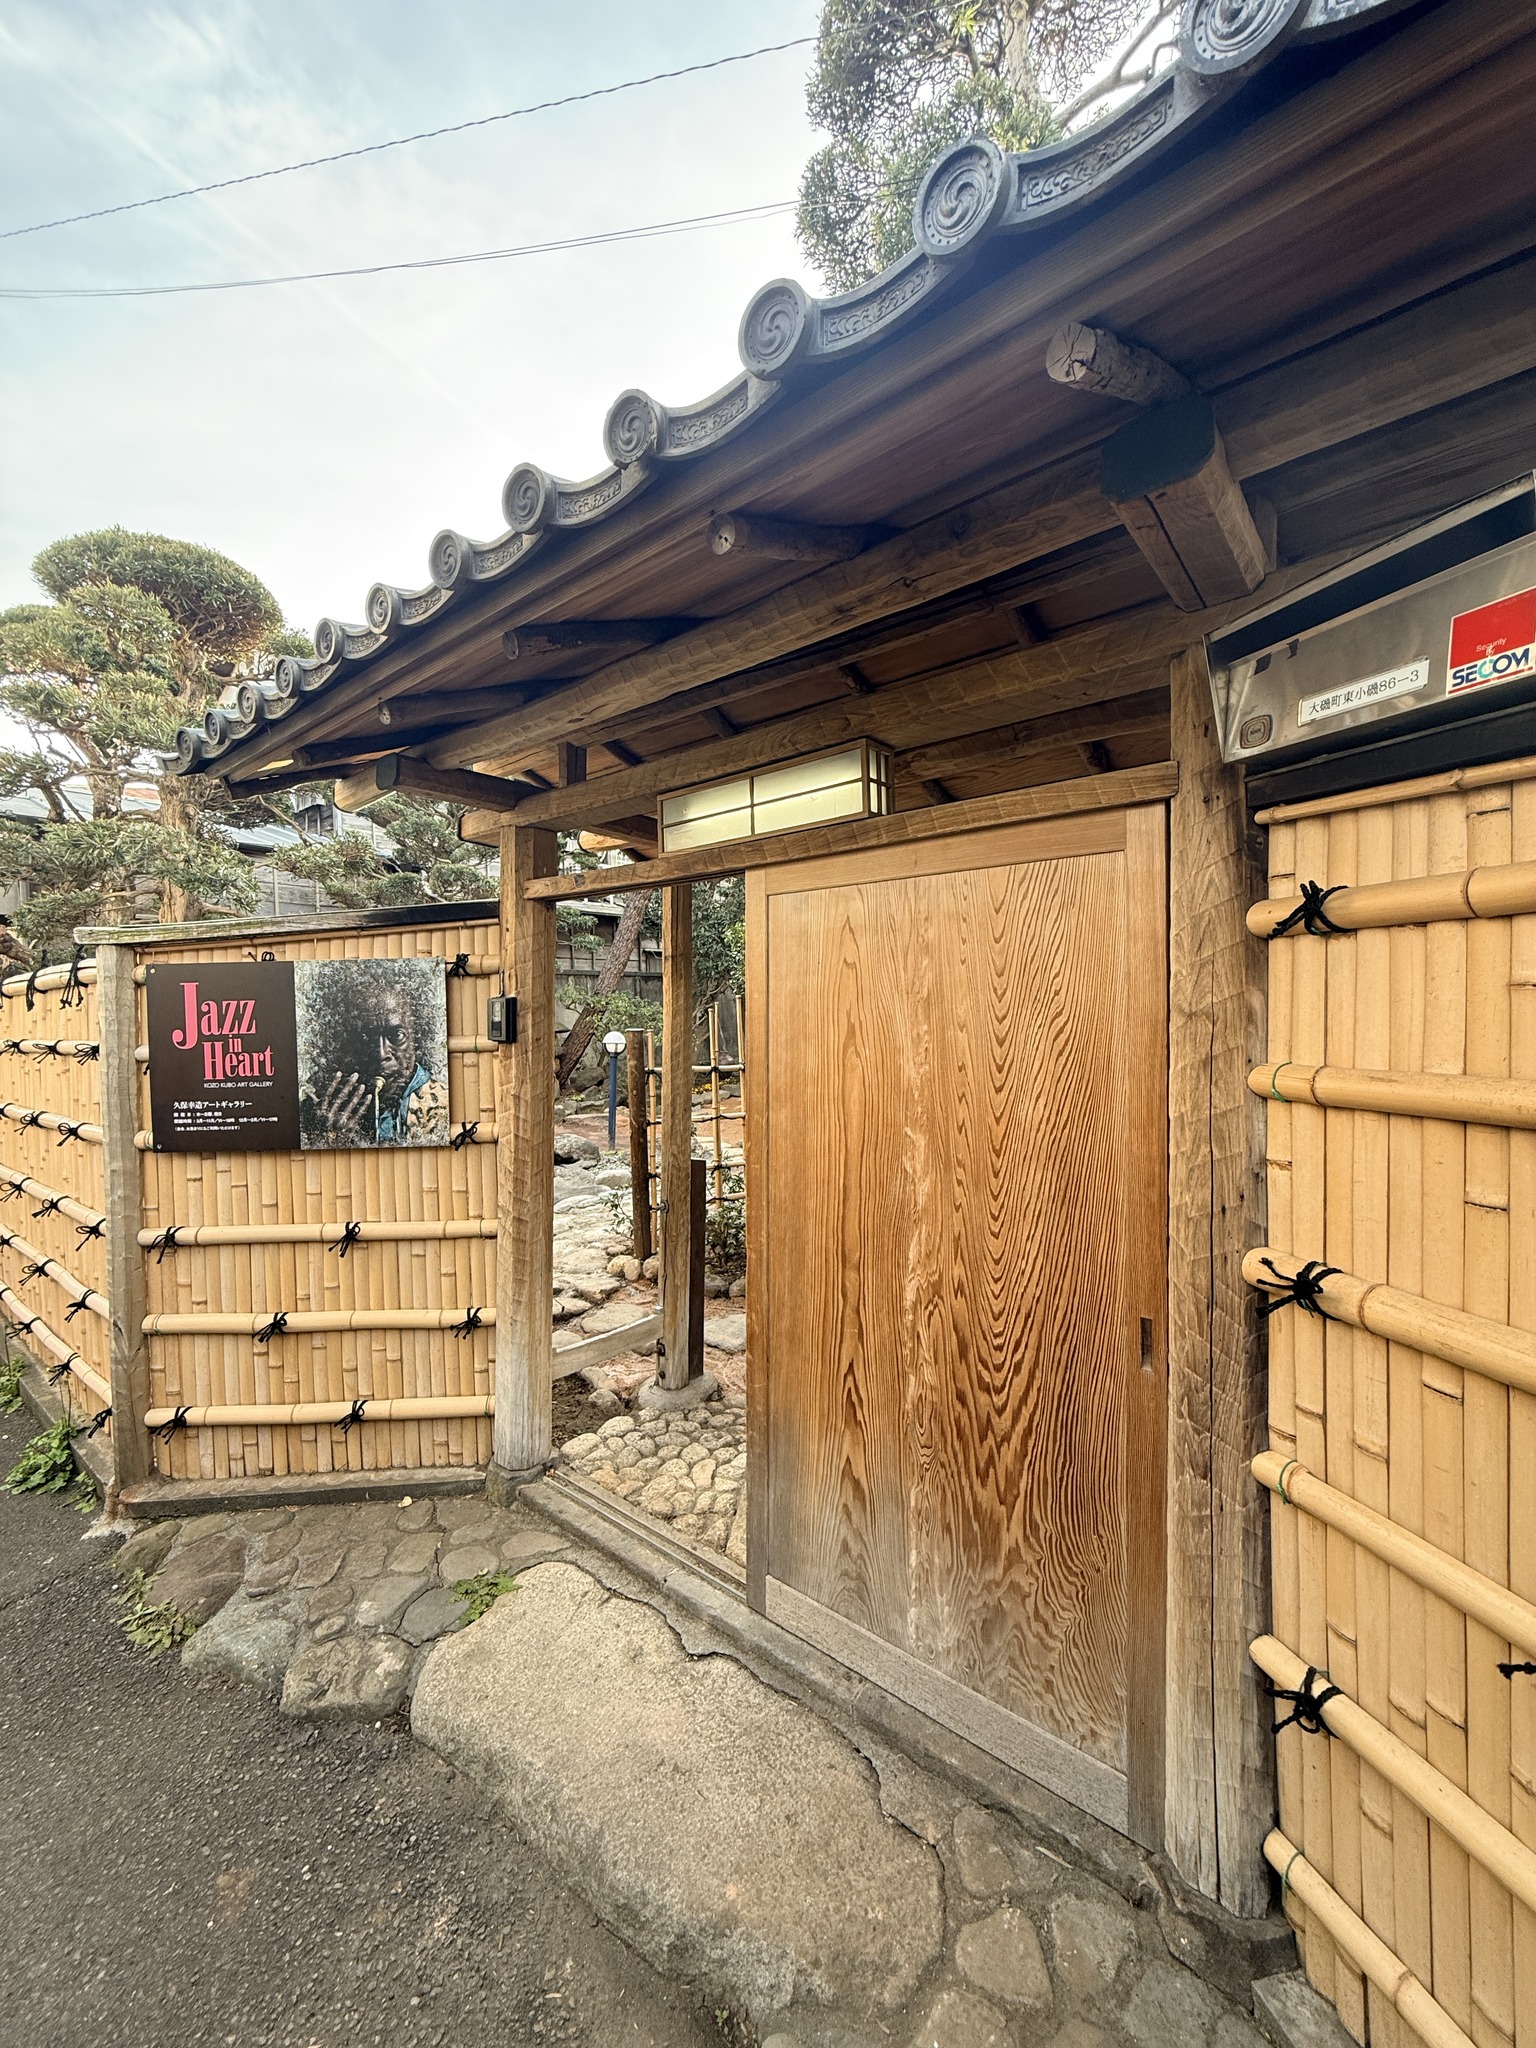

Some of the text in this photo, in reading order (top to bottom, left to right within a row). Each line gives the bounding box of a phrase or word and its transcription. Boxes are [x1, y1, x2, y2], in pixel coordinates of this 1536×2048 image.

[1476, 637, 1507, 653] Security
[1452, 647, 1530, 687] SECOM
[172, 982, 256, 1049] Jazz
[202, 1041, 275, 1080] Heart
[228, 1034, 242, 1053] in
